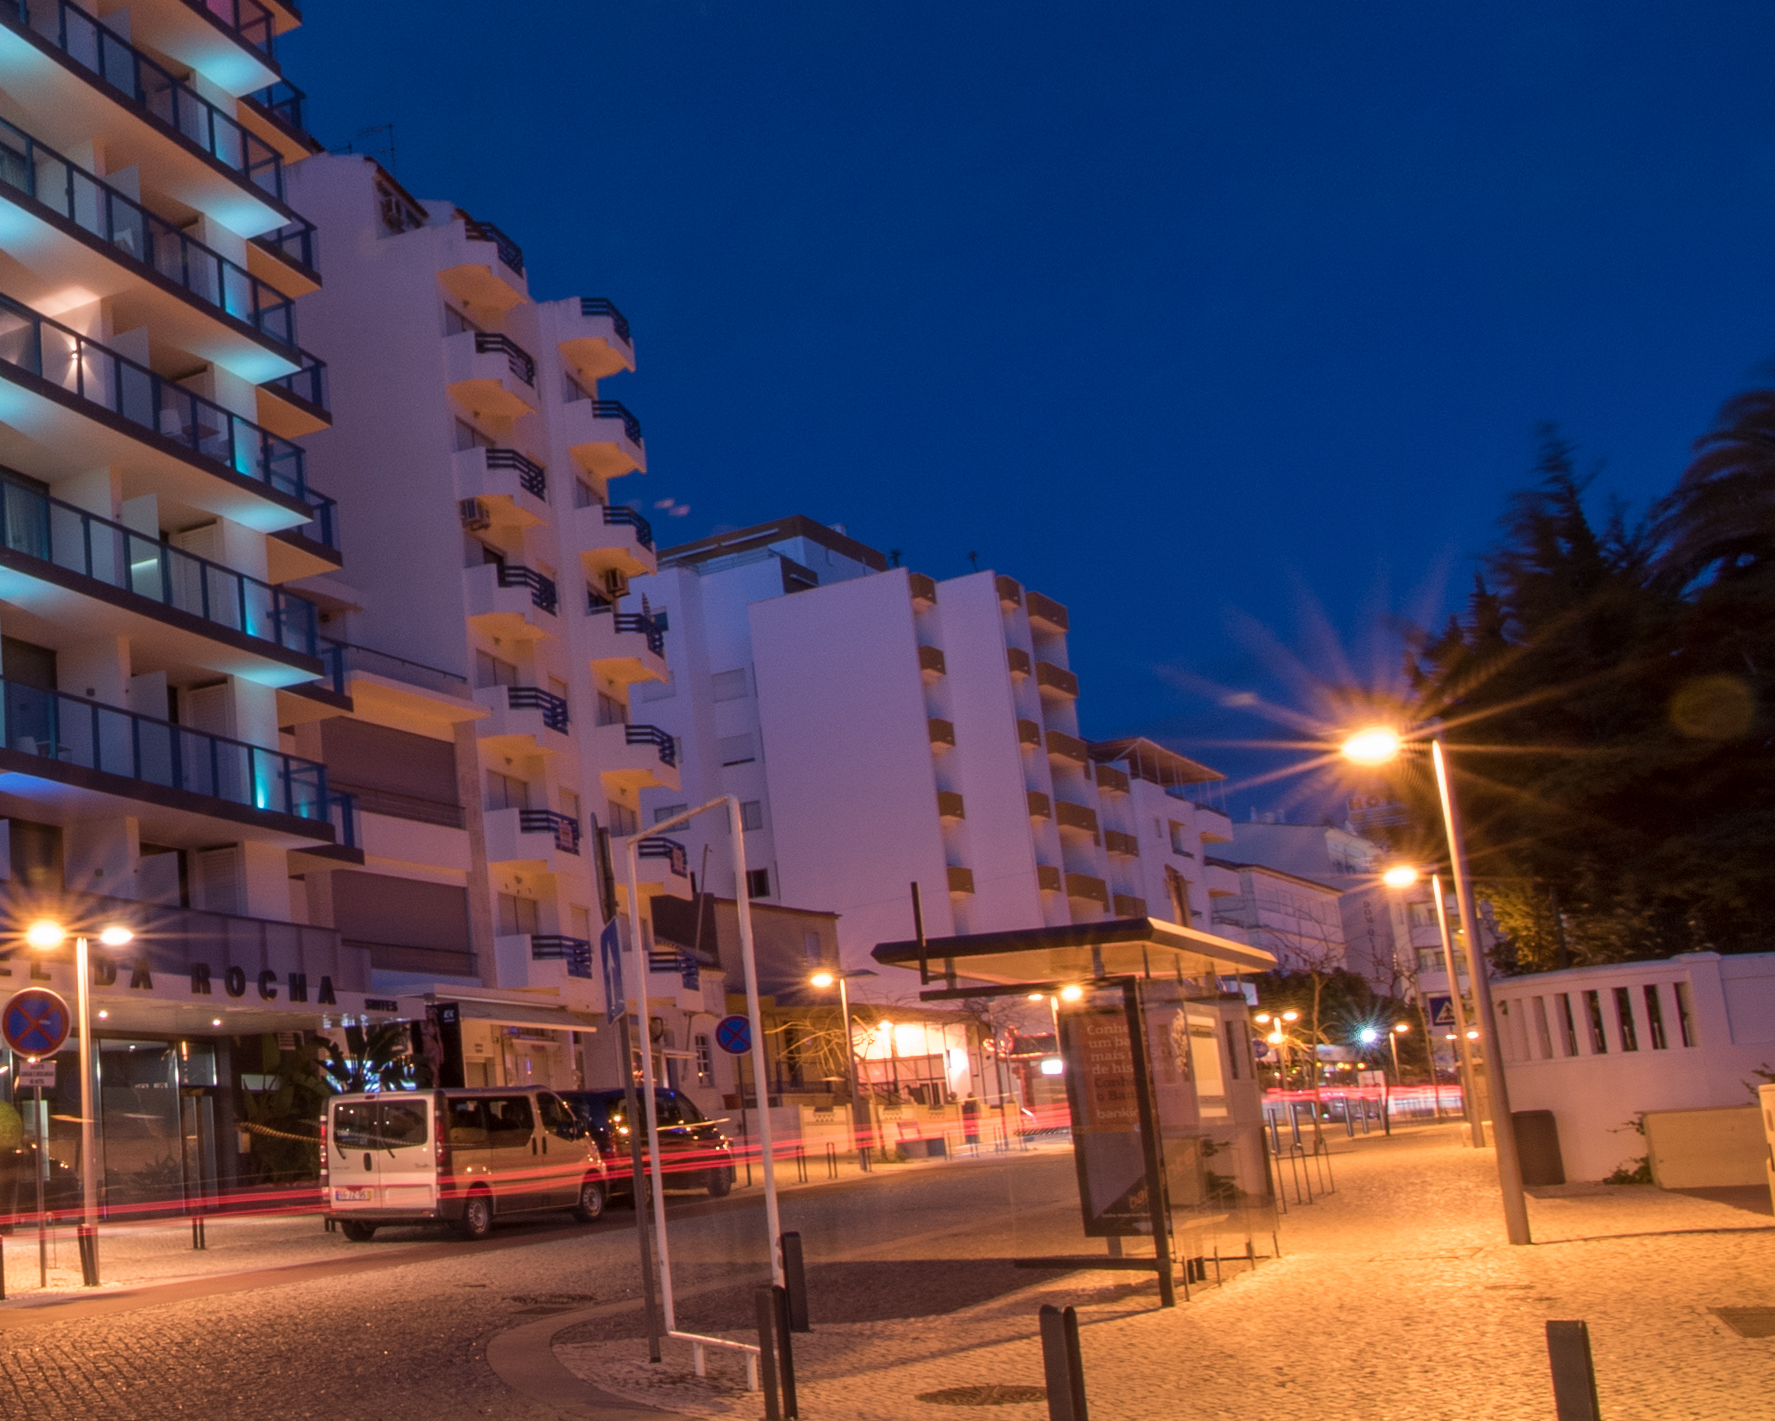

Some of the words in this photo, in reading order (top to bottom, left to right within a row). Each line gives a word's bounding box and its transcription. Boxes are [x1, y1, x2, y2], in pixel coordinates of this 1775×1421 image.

[94, 955, 153, 990] DA
[191, 961, 337, 1006] ROCHA
[1088, 1039, 1112, 1049] um
[1090, 1049, 1125, 1062] mais
[1091, 1063, 1109, 1075] de
